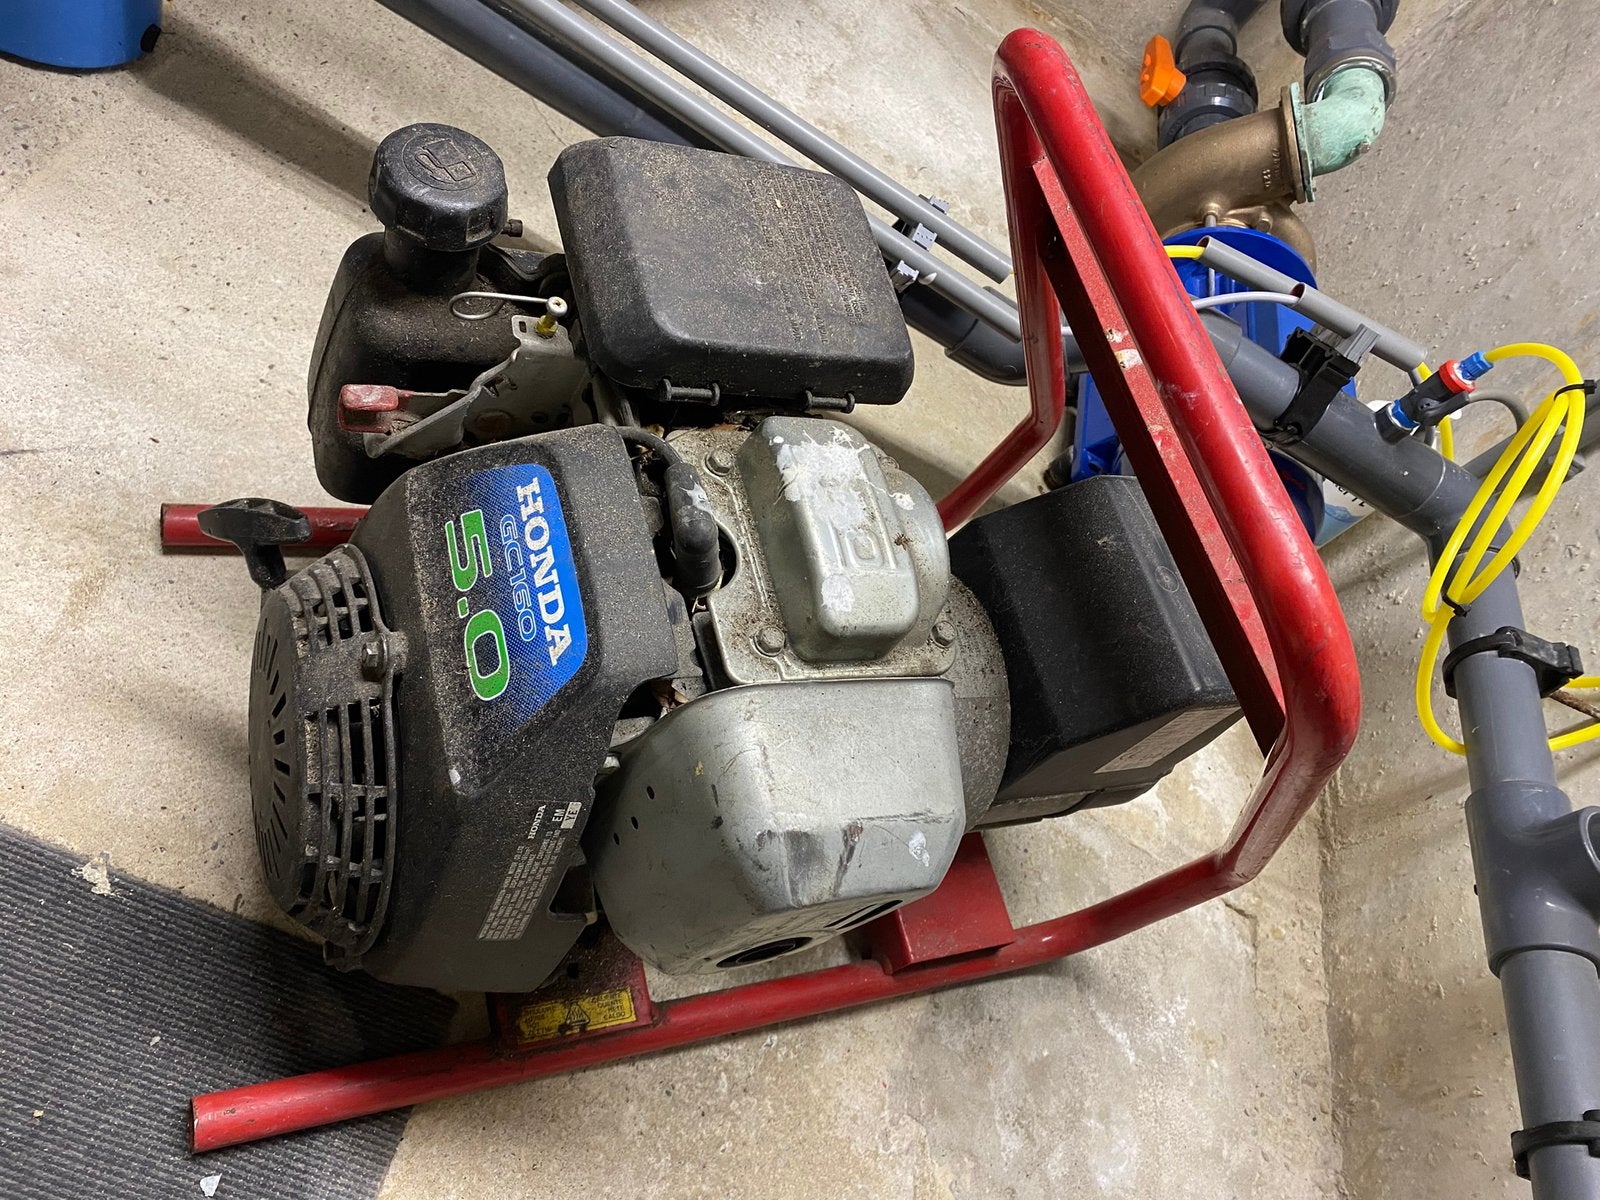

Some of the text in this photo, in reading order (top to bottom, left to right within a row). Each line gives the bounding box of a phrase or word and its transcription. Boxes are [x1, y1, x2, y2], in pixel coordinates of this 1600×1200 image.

[444, 508, 510, 701] 5.0
[500, 514, 537, 642] GC160
[516, 476, 573, 666] HONDA
[527, 804, 546, 839] HONDA
[552, 808, 565, 822] EM
[565, 810, 578, 821] YE
